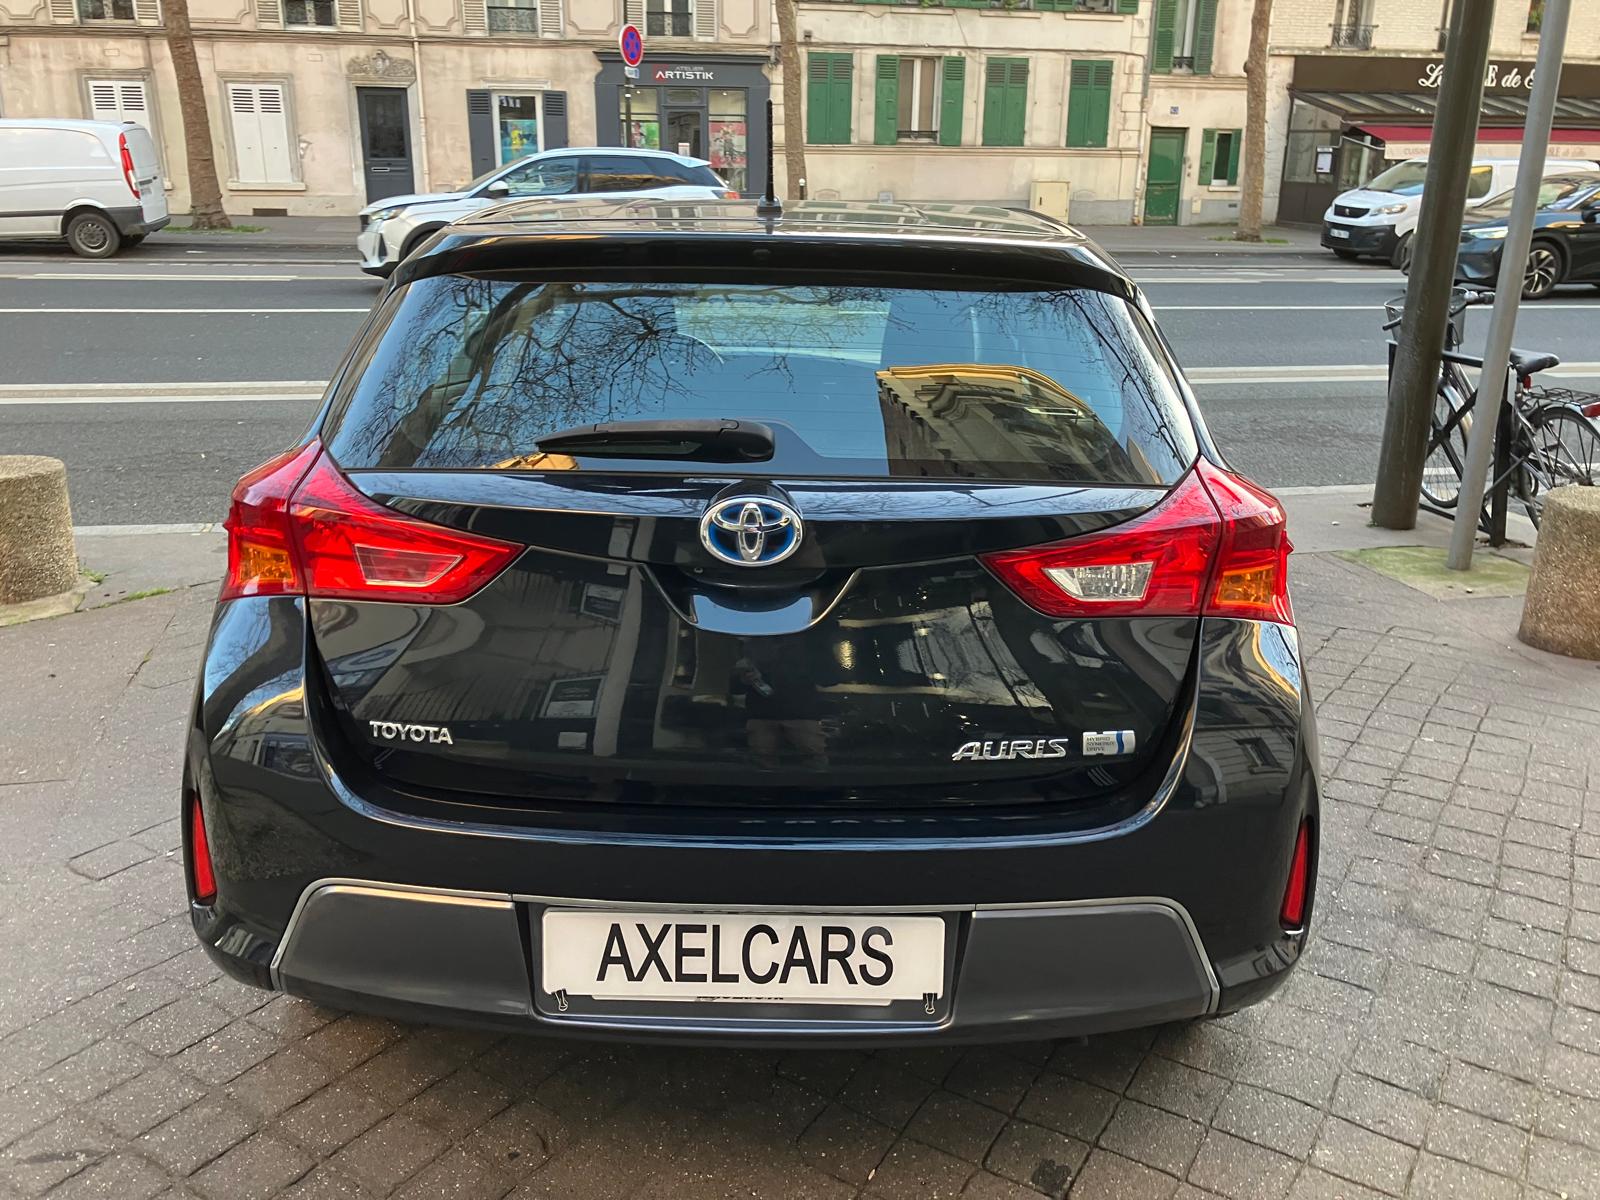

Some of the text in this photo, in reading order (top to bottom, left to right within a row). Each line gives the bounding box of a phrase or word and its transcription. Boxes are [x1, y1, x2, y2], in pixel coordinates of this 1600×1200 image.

[655, 70, 714, 80] ARTISTIK
[1501, 67, 1522, 88] de
[369, 720, 454, 745] TOYOTA
[951, 738, 1069, 761] AURIS
[595, 923, 895, 987] AXELCARS
